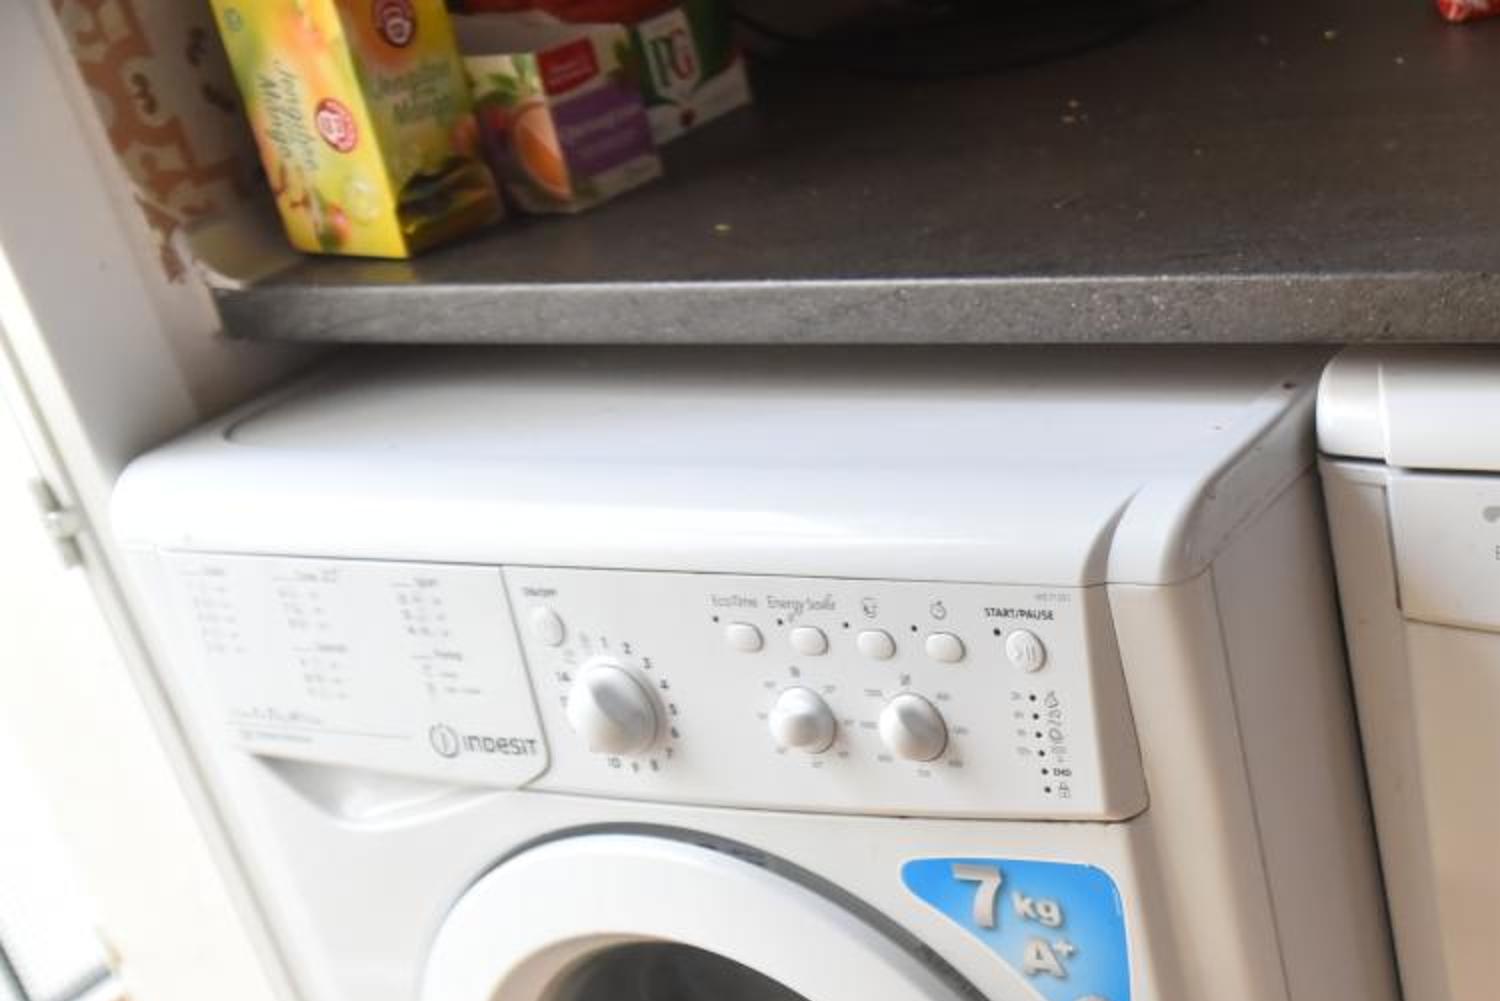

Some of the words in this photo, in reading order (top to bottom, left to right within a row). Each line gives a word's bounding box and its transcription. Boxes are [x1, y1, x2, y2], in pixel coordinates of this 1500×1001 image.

[983, 607, 1055, 622] START/PAUSE
[462, 732, 540, 755] INDESIT
[953, 864, 1004, 929] 7
[1011, 892, 1064, 928] kg
[1024, 937, 1076, 980] A+
